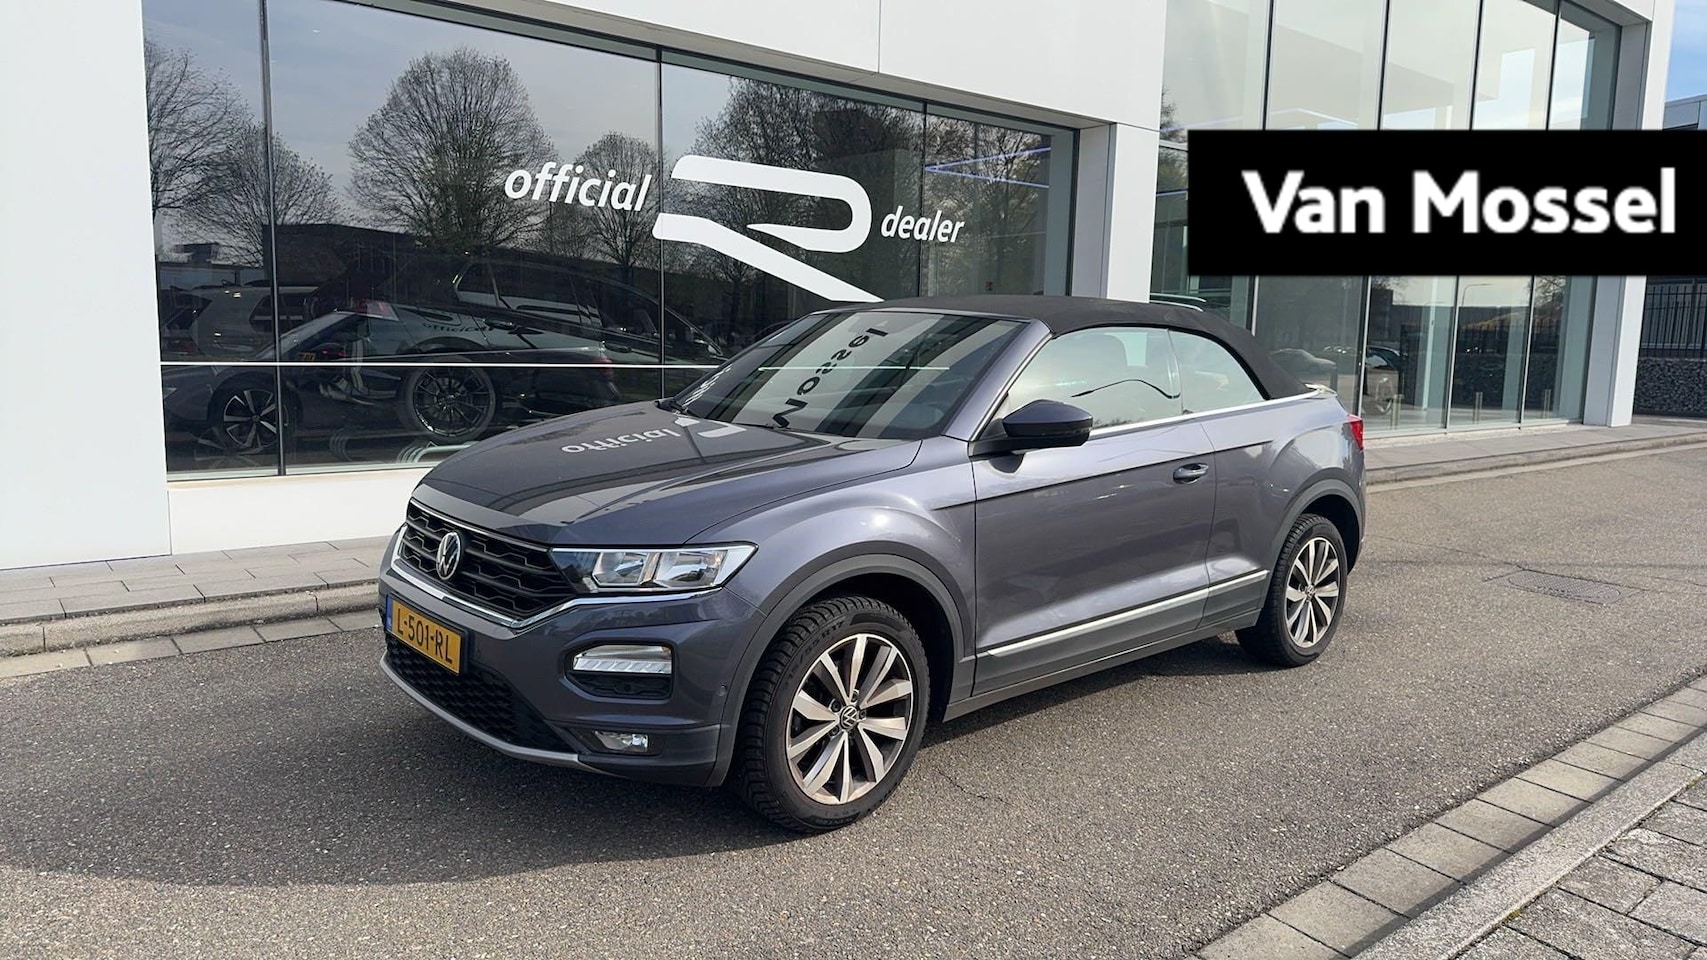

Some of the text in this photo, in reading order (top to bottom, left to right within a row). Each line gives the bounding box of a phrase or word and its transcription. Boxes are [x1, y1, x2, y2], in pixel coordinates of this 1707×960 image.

[504, 155, 966, 302] official R dealer
[396, 608, 454, 664] L-501-RL
